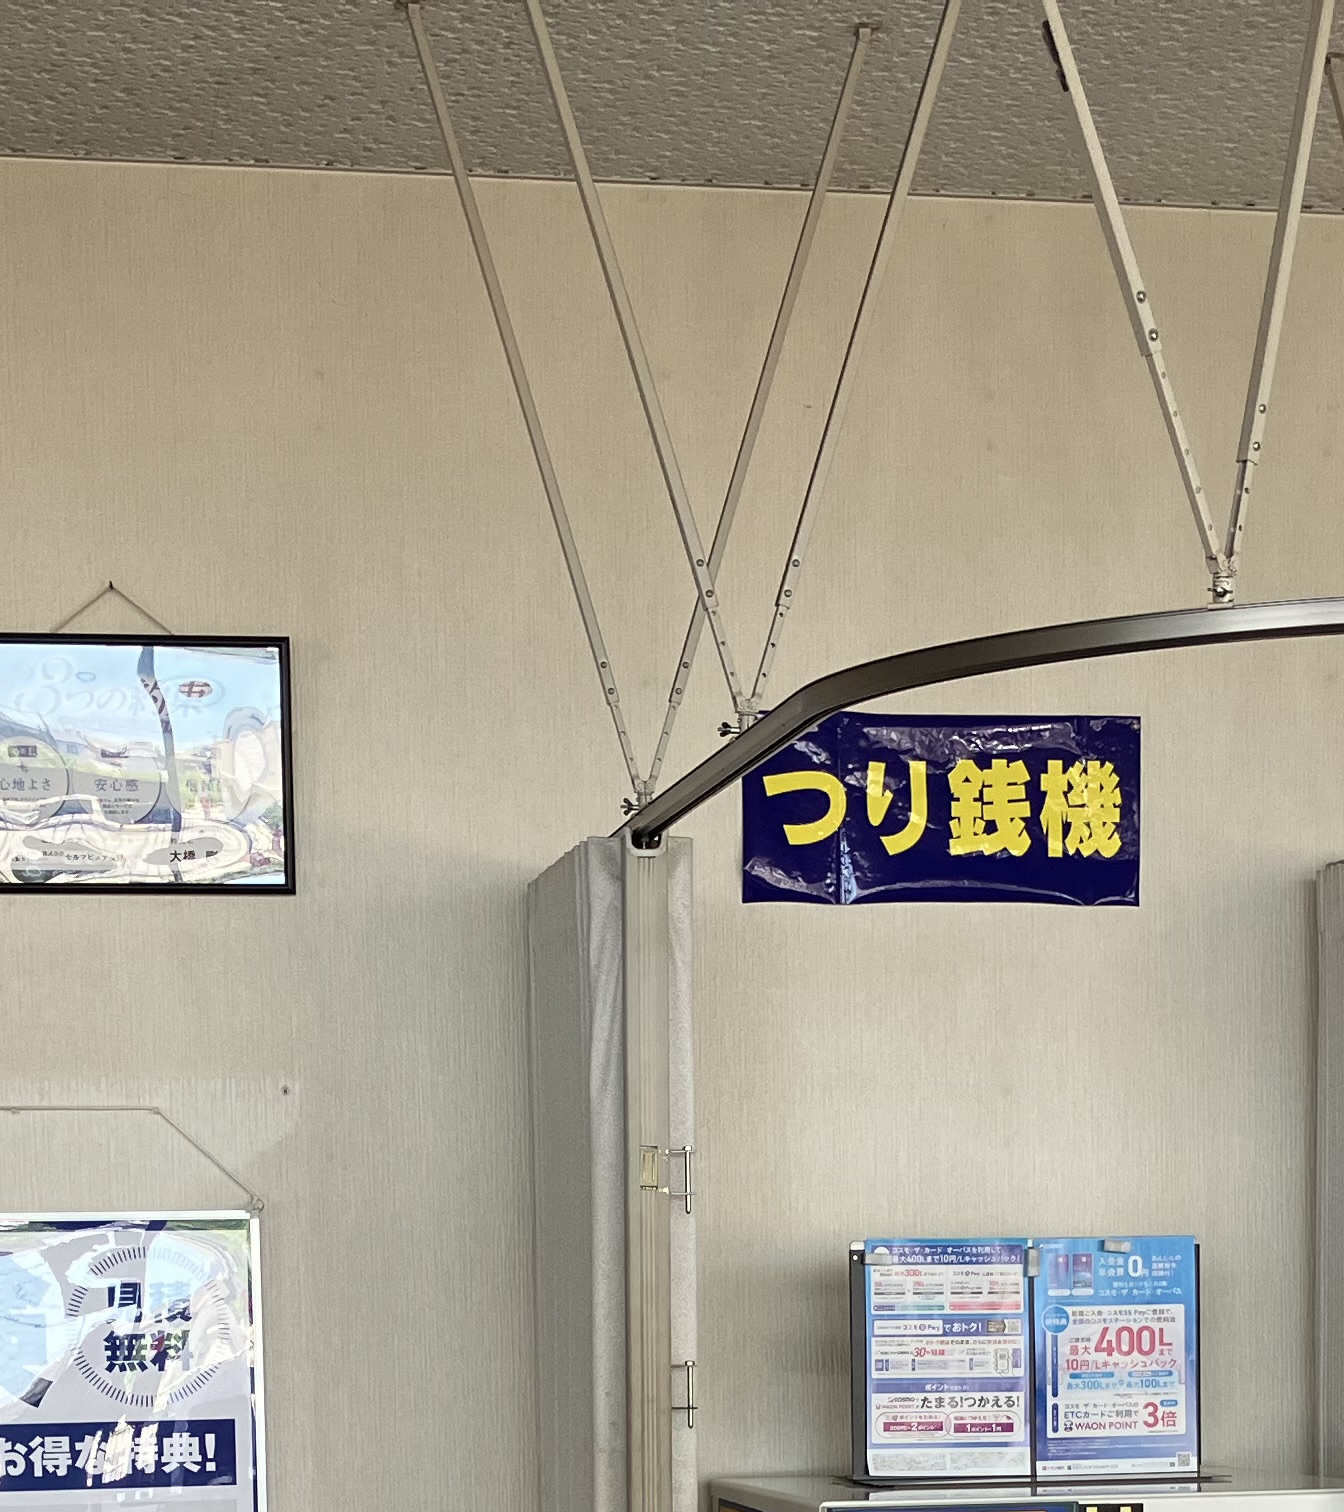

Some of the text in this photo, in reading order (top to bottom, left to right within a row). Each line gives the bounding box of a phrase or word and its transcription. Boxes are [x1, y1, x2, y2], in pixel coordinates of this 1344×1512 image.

[93, 778, 140, 793] 安心感
[762, 758, 1123, 859] つり銭機
[943, 1322, 982, 1333] でおトク!
[1094, 1325, 1173, 1357] 400L
[103, 1329, 194, 1374] 無料
[1068, 1344, 1092, 1356] 最大
[1158, 1347, 1173, 1356] まで
[1065, 1358, 1178, 1371] 10円/Lキャッシュバック
[920, 1395, 1021, 1410] たまる!つかえる!
[1064, 1409, 1140, 1419] ETCカードご利用で
[1142, 1401, 1178, 1429] 3倍
[1074, 1421, 1138, 1431] WAON POINT
